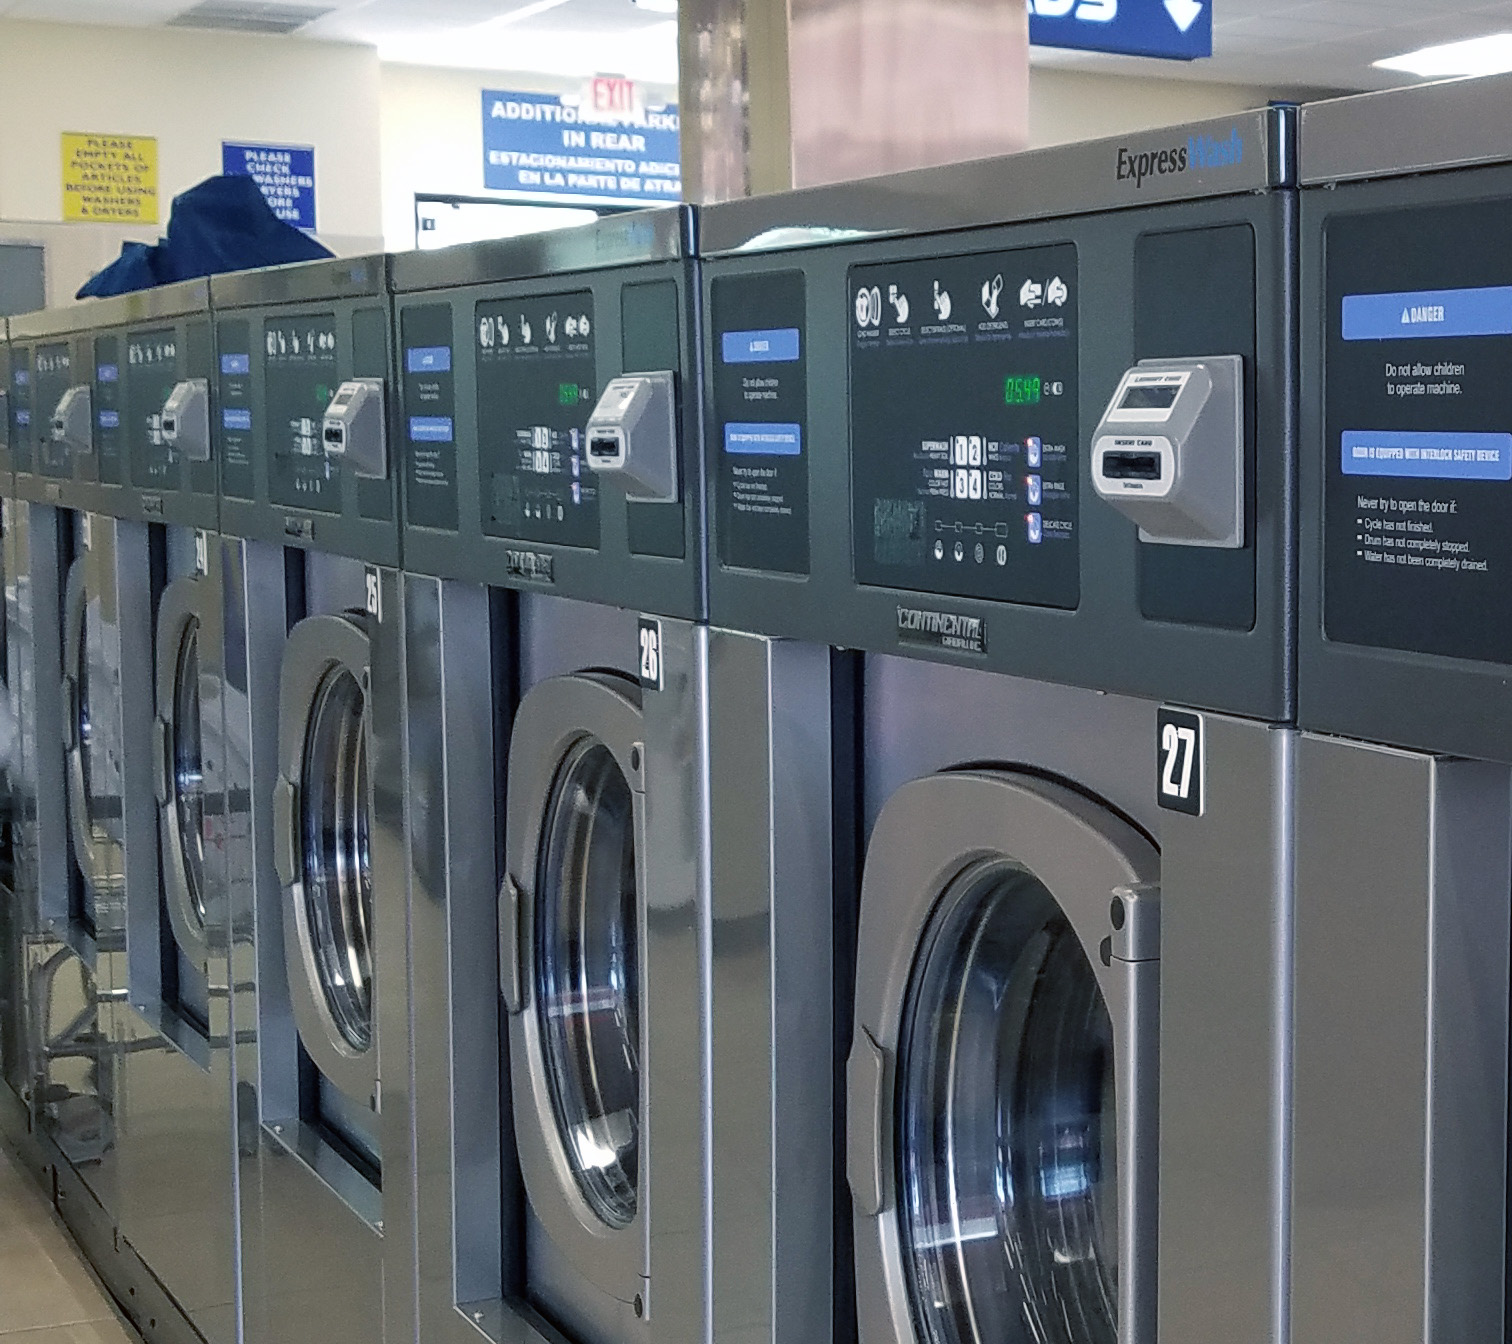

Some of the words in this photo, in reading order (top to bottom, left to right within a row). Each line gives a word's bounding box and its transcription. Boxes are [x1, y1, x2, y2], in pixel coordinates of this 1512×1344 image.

[592, 78, 634, 112] EXIT
[562, 130, 586, 148] IN
[590, 131, 646, 152] REAR
[518, 170, 541, 185] EN
[543, 172, 565, 187] LA
[567, 173, 617, 190] PARTE
[1410, 305, 1445, 323] DANGER
[1385, 363, 1397, 377] Do
[1398, 363, 1411, 377] not
[1412, 362, 1433, 376] allow
[1433, 361, 1465, 376] children
[1387, 381, 1395, 395] to
[1396, 382, 1425, 398] operate
[1426, 381, 1463, 395] machine.
[1357, 495, 1379, 510] Never
[1379, 497, 1390, 513] try
[1390, 498, 1398, 511] to
[1398, 500, 1417, 514] open
[1418, 499, 1430, 512] the
[1431, 499, 1449, 513] door
[1364, 517, 1382, 531] Cycle
[1383, 519, 1395, 531] has
[1396, 520, 1406, 531] not
[1406, 538, 1441, 553] completely
[640, 627, 657, 681] 26
[1162, 723, 1195, 799] 27
